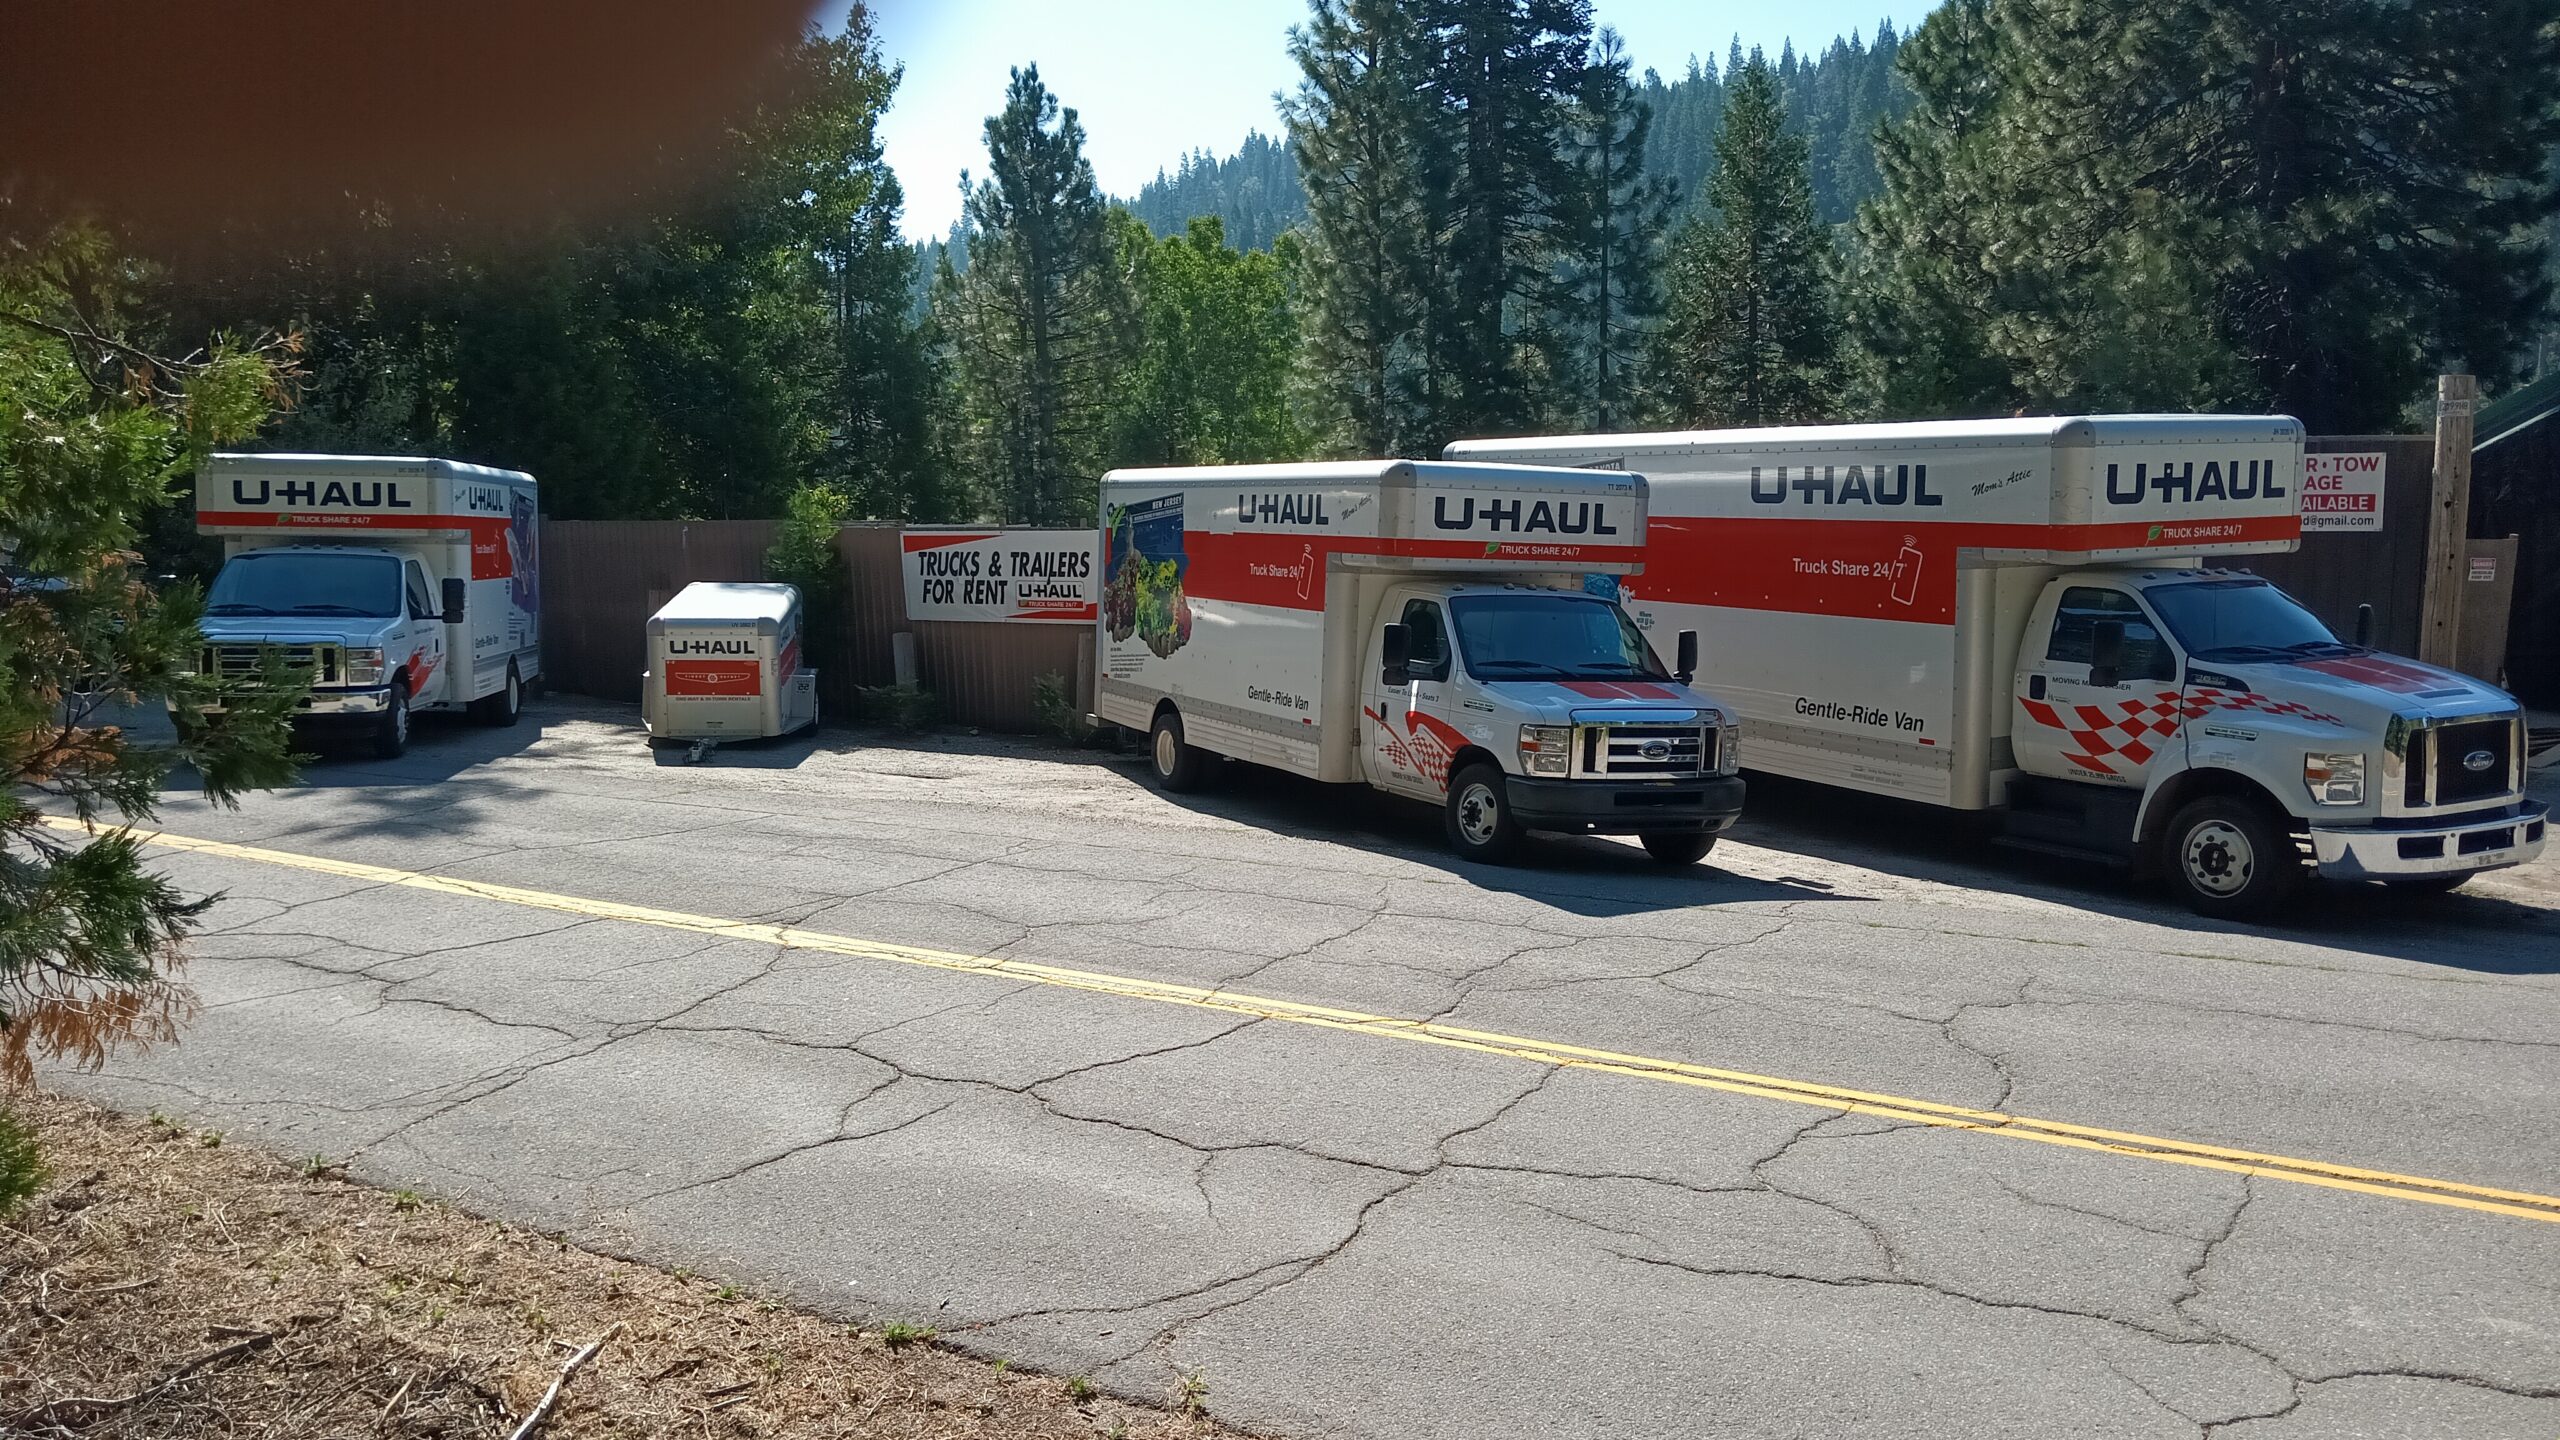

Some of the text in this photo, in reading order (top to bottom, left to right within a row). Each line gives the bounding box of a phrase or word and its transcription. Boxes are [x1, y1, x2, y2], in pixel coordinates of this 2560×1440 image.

[2306, 457, 2379, 472] R TOW
[233, 480, 411, 507] U-HAUL
[1751, 465, 1943, 506] U-HAUL
[1971, 469, 2033, 496] Mom's Attic
[2106, 460, 2285, 504] U-HAUL
[2304, 475, 2343, 490] AGE
[469, 486, 503, 511] U-HAUL
[1238, 494, 1329, 525] U-HAUL
[2301, 496, 2369, 510] AILABLE
[1434, 496, 1617, 535] U-HAUL
[2303, 515, 2374, 527] d@gmail.com
[2163, 524, 2242, 538] TRUCK SHARE 24/7
[1500, 545, 1580, 556] TRUCK SHARE 24/7
[918, 551, 1090, 578] TRUCKS & TRAILERS
[1249, 563, 1305, 580] Truck Share 24/7
[1793, 558, 1904, 581] Truck Share 24/7
[922, 579, 1008, 604] FOR RENT
[1018, 584, 1082, 598] U-HAUL
[670, 640, 755, 654] U-HAUL
[2052, 676, 2080, 686] MOVING
[1248, 685, 1309, 711] Gentle-Ride Van
[1795, 697, 1924, 732] Gentle-Ride Van
